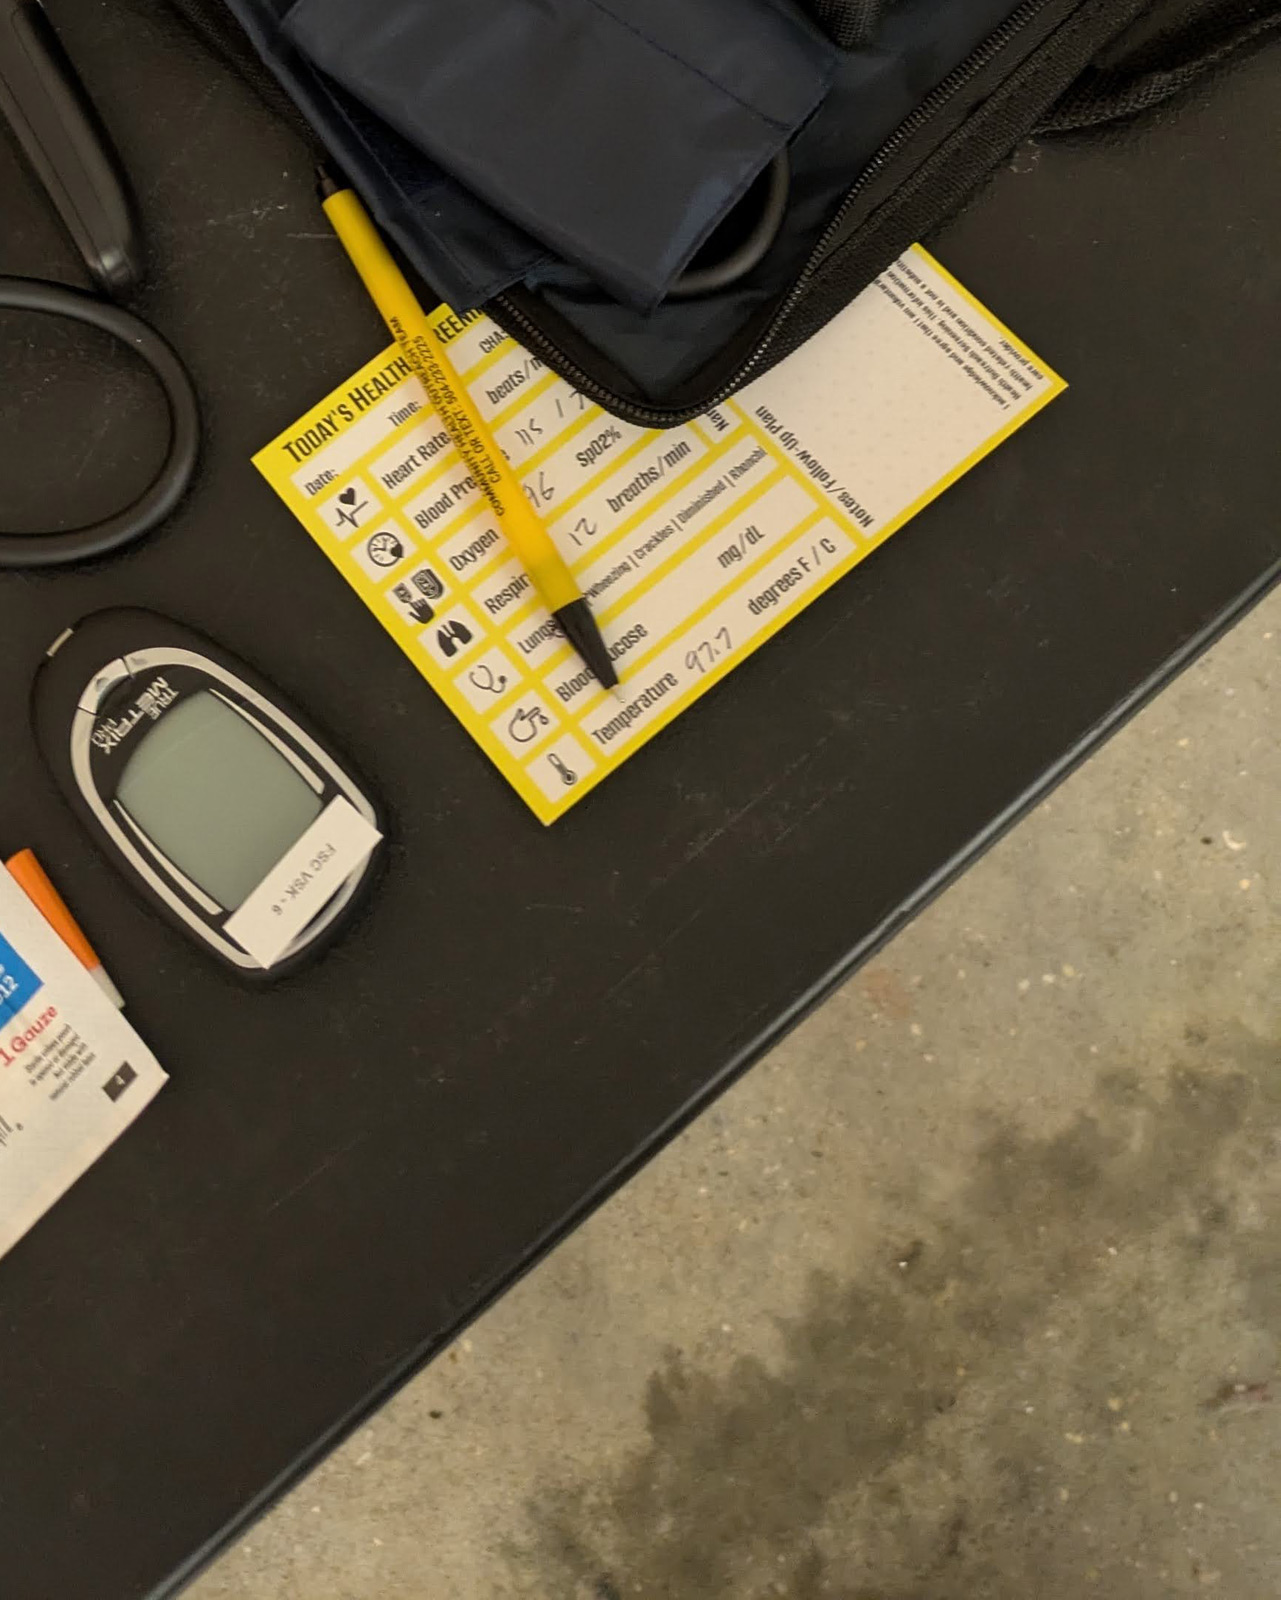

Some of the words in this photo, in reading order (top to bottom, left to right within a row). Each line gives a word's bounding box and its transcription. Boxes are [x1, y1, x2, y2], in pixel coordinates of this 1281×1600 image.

[886, 271, 924, 307] information
[922, 306, 937, 320] This
[390, 316, 409, 347] TEAM
[479, 325, 510, 354] CHA:
[932, 335, 952, 353] agree
[406, 348, 442, 405] OUTREACH
[412, 336, 458, 405] 504-233-2225
[969, 350, 999, 380] Outreach
[348, 356, 414, 412] HEALTH
[998, 378, 1021, 400] Health
[388, 401, 422, 427] Time:
[438, 406, 467, 448] HEALTH
[452, 410, 475, 437] TEXT:
[755, 406, 783, 434] Plan
[381, 455, 422, 490] Heart
[416, 432, 452, 461] Rate
[470, 437, 484, 454] OR
[305, 470, 339, 496] Date:
[462, 450, 504, 516] COMMUNITY
[480, 455, 501, 484] CALL
[606, 441, 692, 513] breaths/min
[779, 431, 874, 528] Notes/Follow-Up
[414, 492, 455, 529] Blood
[586, 562, 632, 598] Wheezing
[633, 525, 675, 560] Crackles
[676, 480, 727, 524] Diminished
[728, 446, 767, 480] Rhonchi
[449, 528, 500, 571] Oxygen
[717, 525, 766, 568] mg/dL
[748, 567, 804, 616] degrees
[797, 556, 811, 573] F
[820, 538, 836, 554] C
[98, 677, 169, 754] METRIX
[146, 686, 179, 720] TRUE
[592, 673, 678, 745] Temperature
[310, 843, 336, 872] FSC
[285, 872, 314, 898] VSK
[11, 1006, 58, 1053] Gauze
